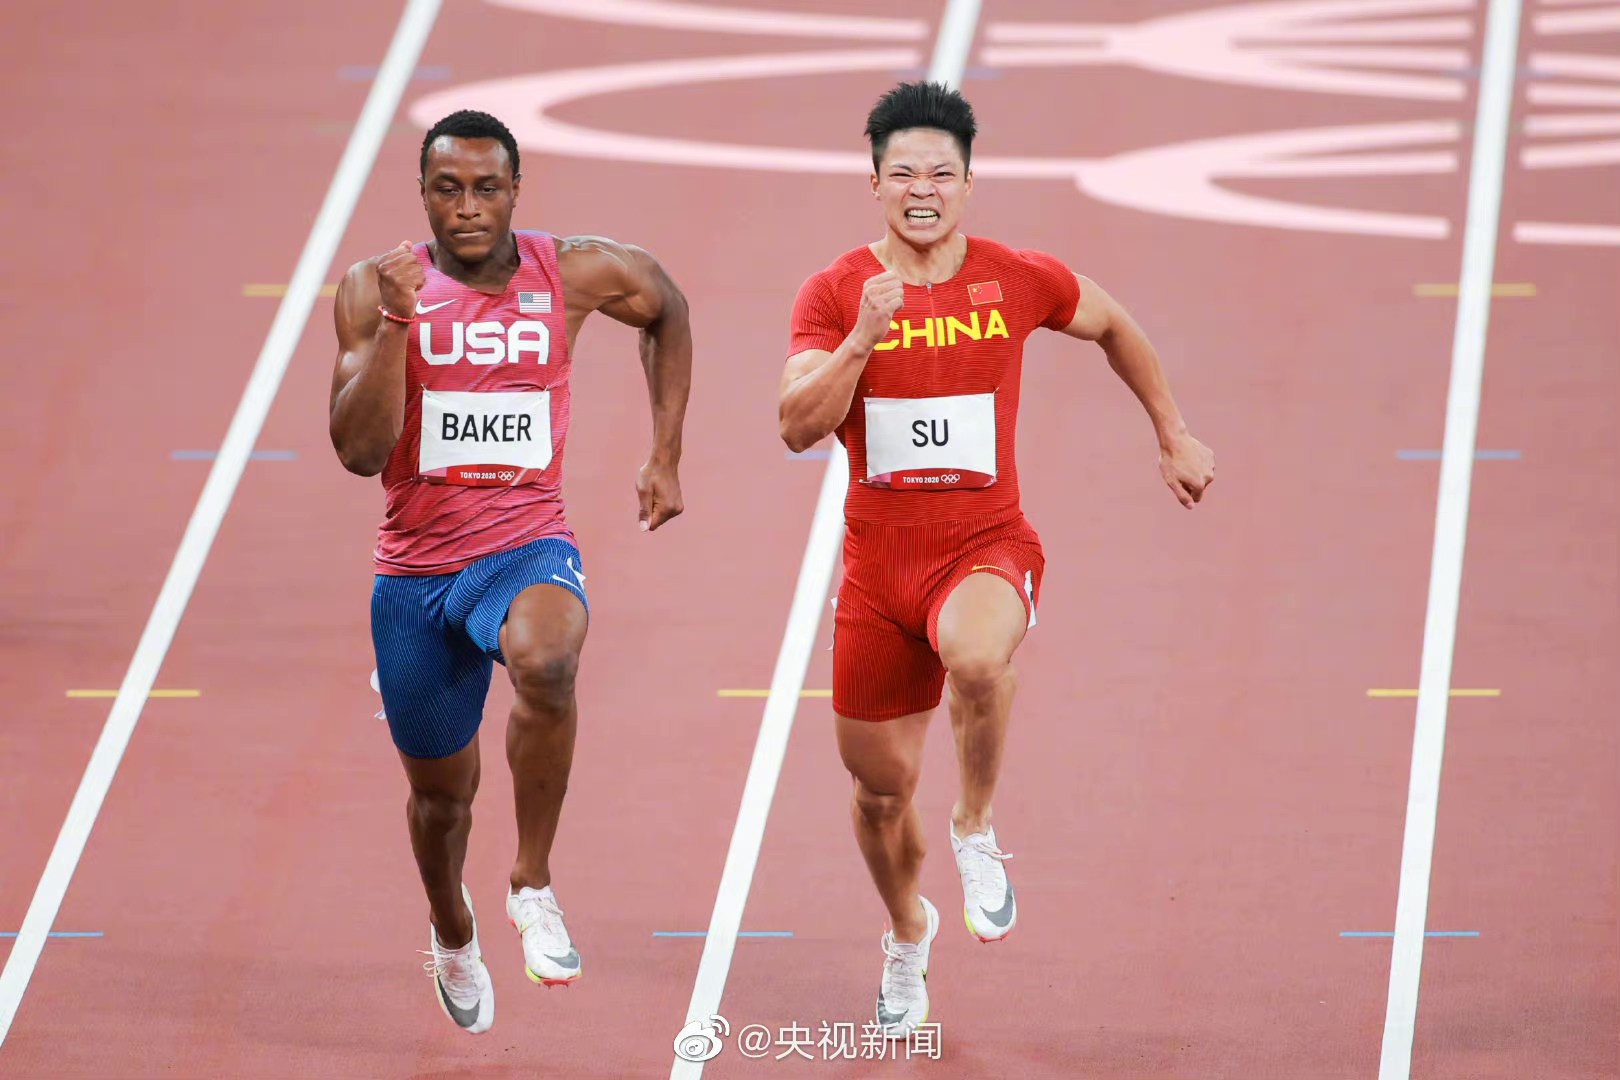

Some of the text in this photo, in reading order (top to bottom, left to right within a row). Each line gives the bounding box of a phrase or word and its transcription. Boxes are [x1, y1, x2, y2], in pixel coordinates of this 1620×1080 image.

[418, 320, 551, 366] USA
[441, 412, 533, 442] BAKER
[911, 418, 949, 448] SU
[460, 471, 480, 479] TOKYO
[903, 476, 940, 484] TOKYO 2020
